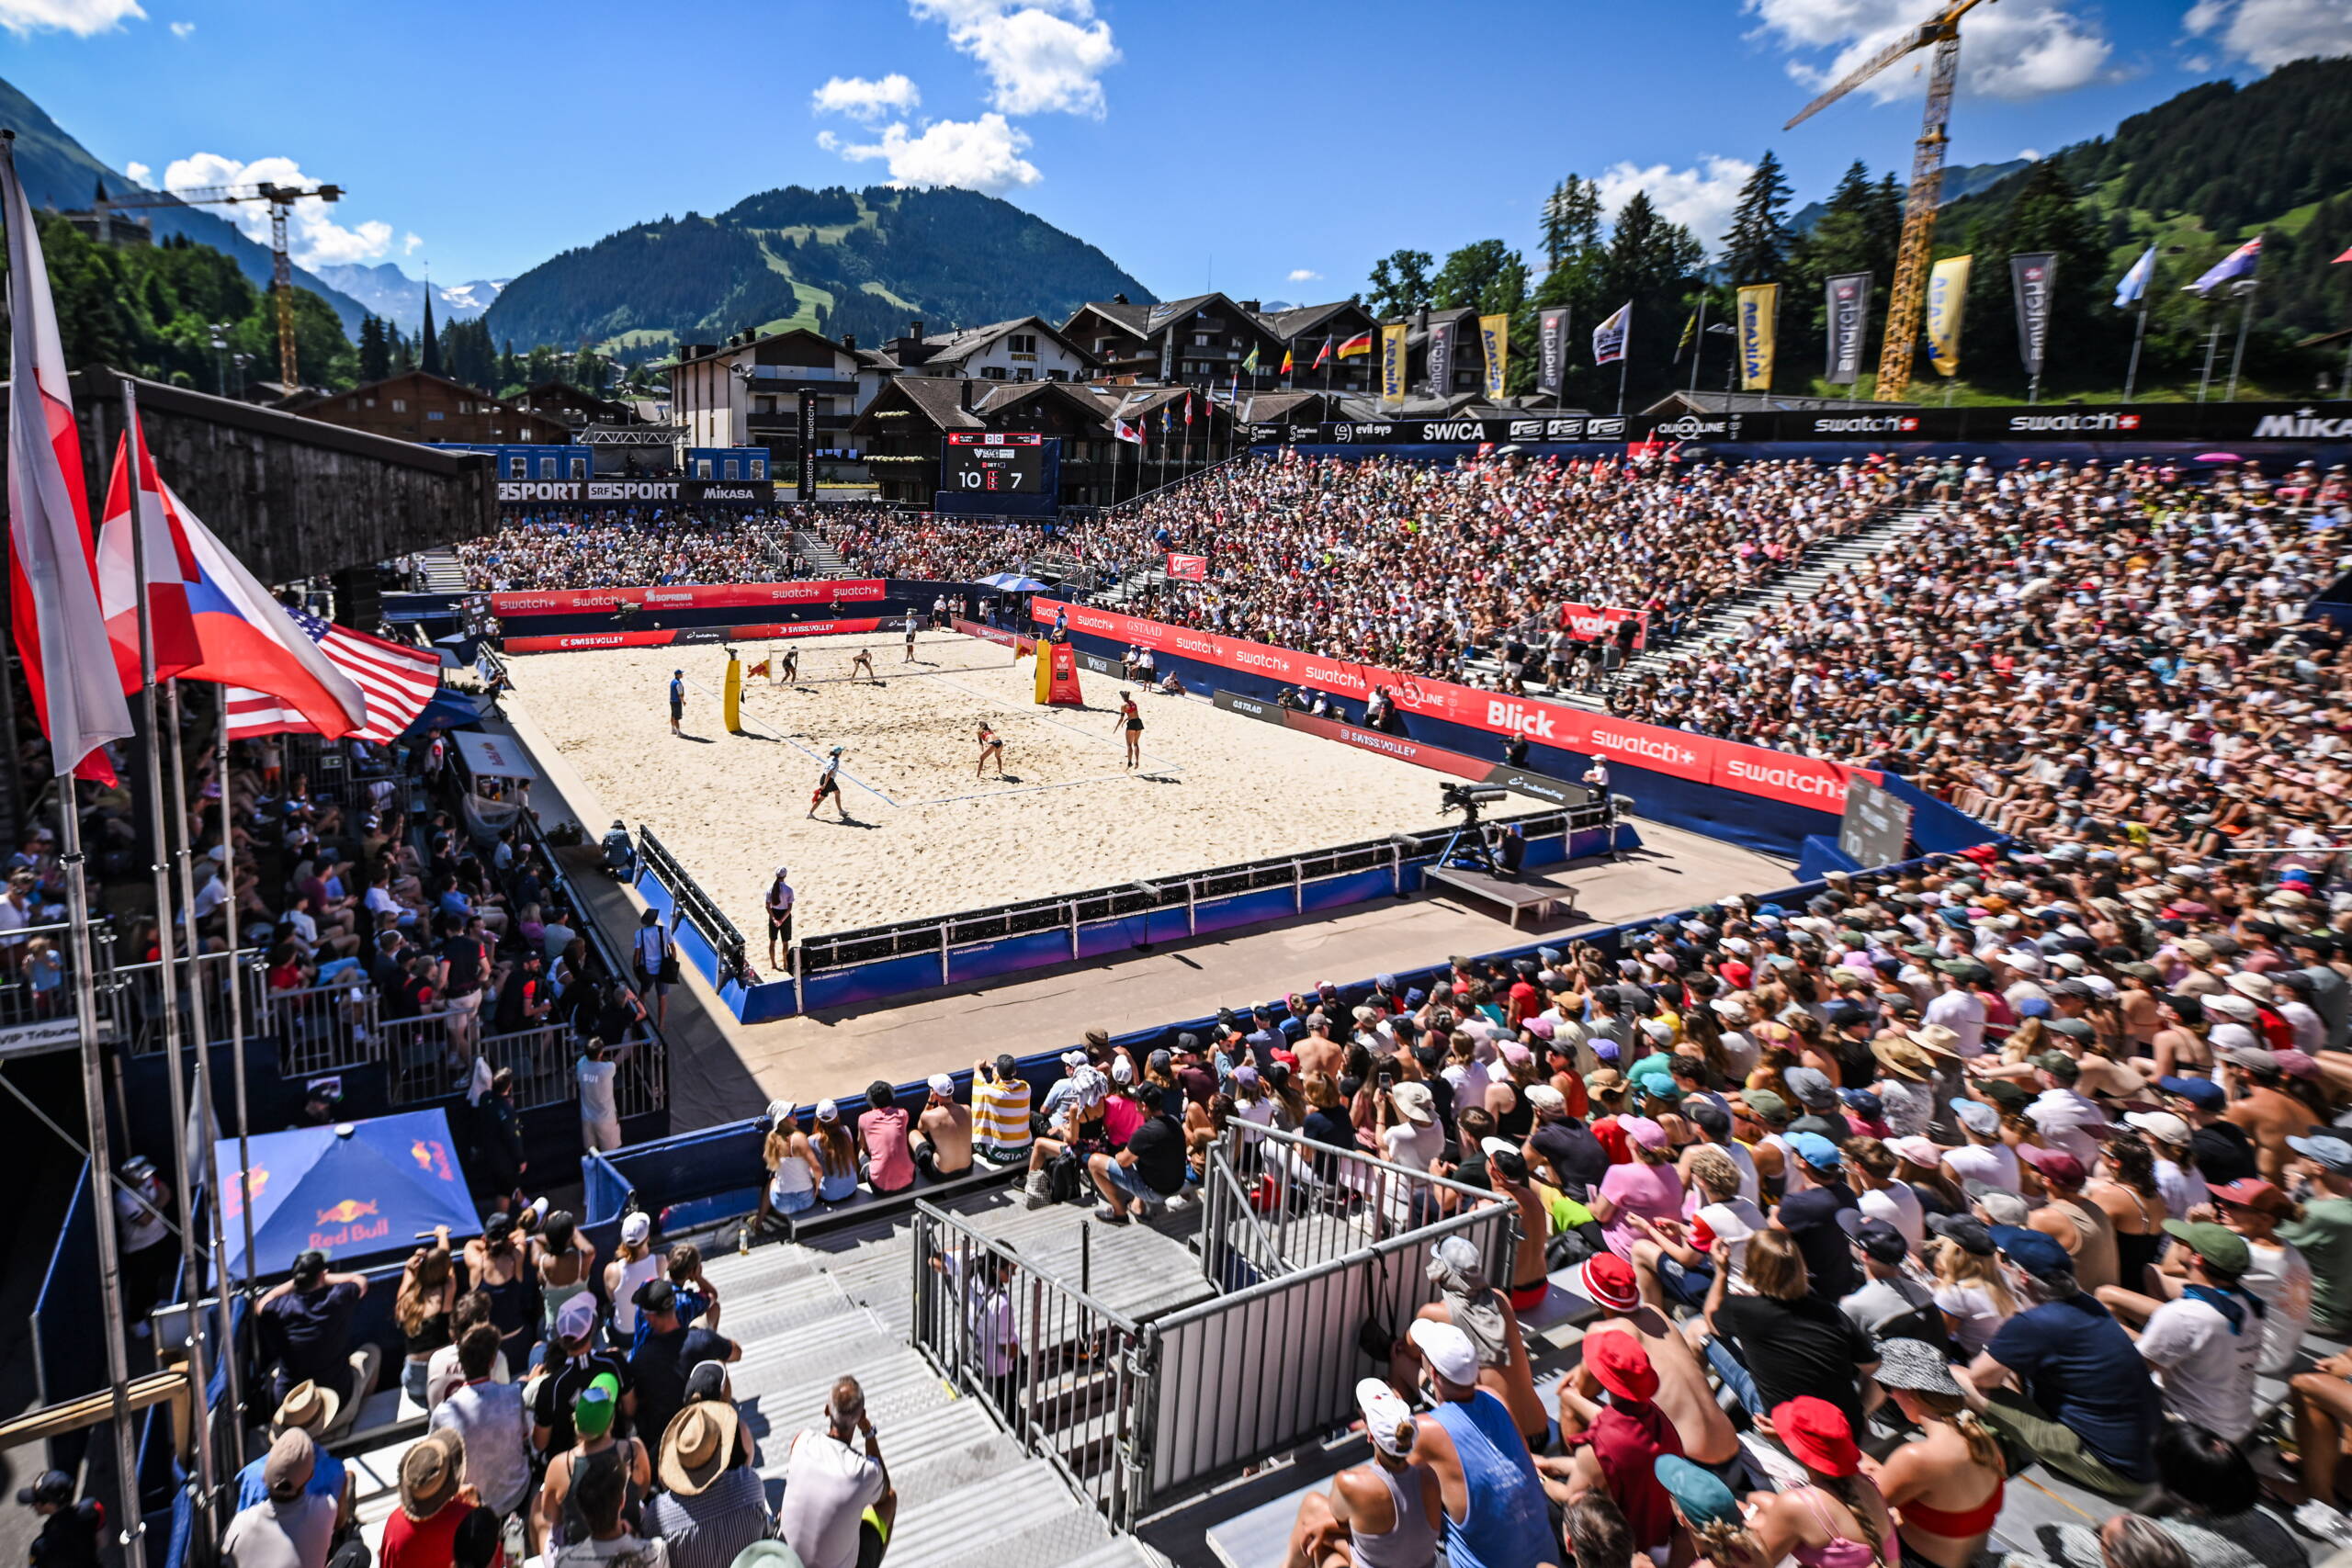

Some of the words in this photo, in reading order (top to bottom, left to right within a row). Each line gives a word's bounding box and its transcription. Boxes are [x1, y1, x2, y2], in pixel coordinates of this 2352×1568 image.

[1356, 423, 1373, 434] evil
[1422, 423, 1487, 441] SWICA
[958, 471, 982, 489] 10
[1010, 472, 1023, 489] 7
[508, 483, 581, 500] SPORT
[591, 487, 610, 496] SRF
[612, 483, 680, 500] SPORT
[1126, 620, 1162, 637] GSTAAD
[1487, 700, 1555, 739] Blick
[583, 1074, 598, 1083] SUI
[309, 1227, 348, 1248] Red
[352, 1219, 389, 1241] Bull
